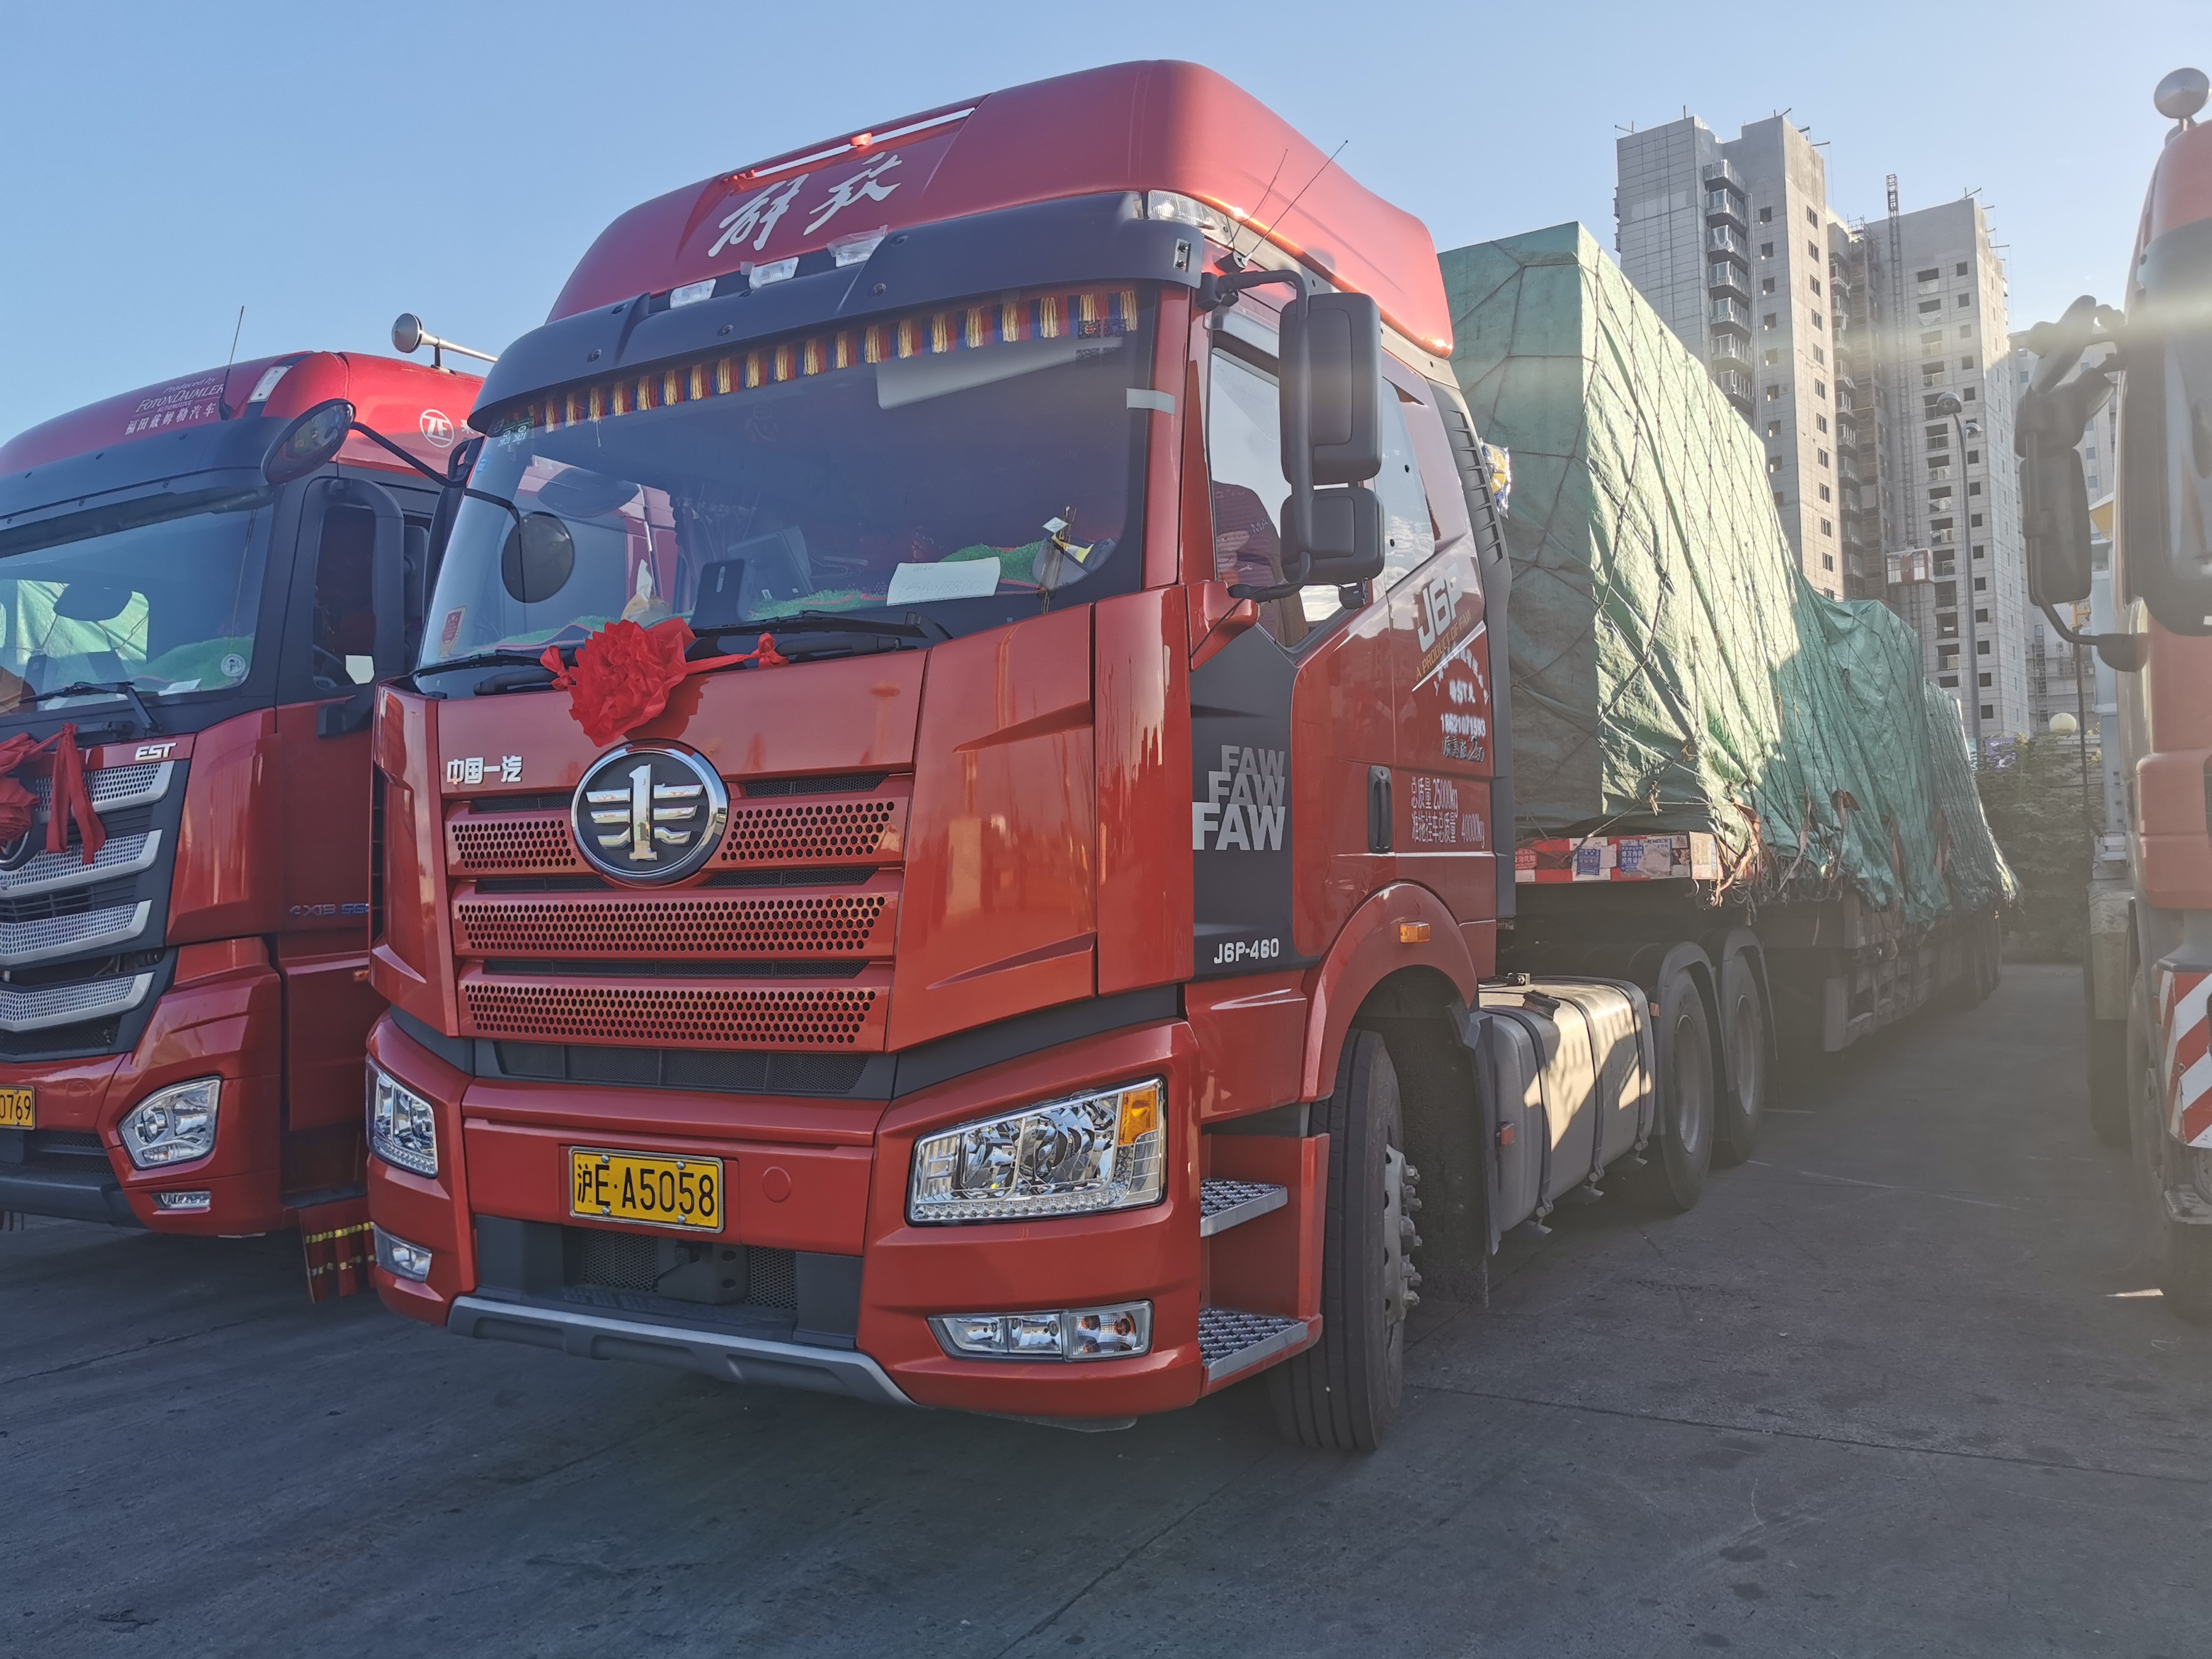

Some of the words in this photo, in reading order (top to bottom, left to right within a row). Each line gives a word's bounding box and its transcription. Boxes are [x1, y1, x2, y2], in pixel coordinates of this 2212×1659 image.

[125, 402, 216, 435] 福田戴姆勒汽车
[421, 413, 454, 444] ZF
[1418, 563, 1463, 653] J6P
[1421, 631, 1450, 674] PRODUCT
[1450, 622, 1459, 640] OF
[135, 742, 177, 761] EST
[1221, 745, 1285, 783] FAW
[446, 755, 523, 785] 中国一汽
[1208, 771, 1285, 813] FAW
[1191, 801, 1285, 850] FAW
[1213, 937, 1279, 964] J6P-460
